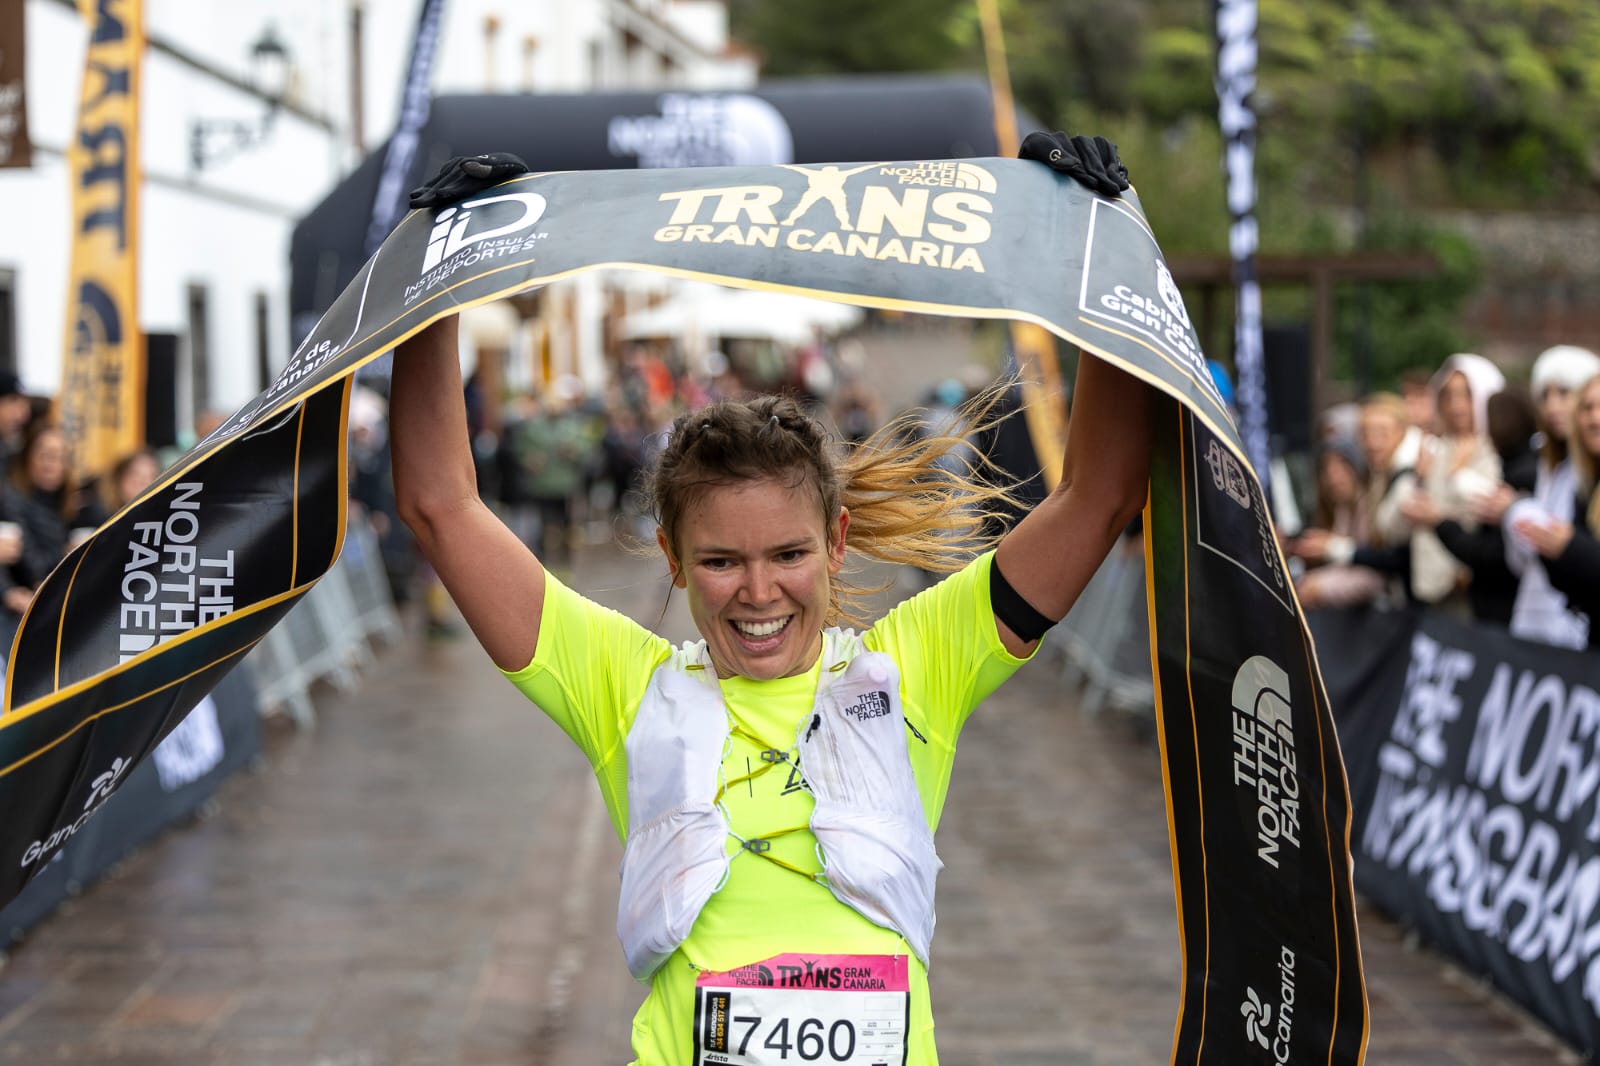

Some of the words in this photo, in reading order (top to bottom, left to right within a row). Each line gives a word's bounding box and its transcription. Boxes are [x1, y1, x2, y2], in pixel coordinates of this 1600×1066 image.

[880, 167, 955, 179] NORTH
[898, 176, 954, 187] FACE
[915, 161, 956, 171] THE
[654, 224, 780, 247] GRAN
[787, 229, 986, 273] CANARIA
[404, 290, 423, 306] DE
[426, 240, 536, 291] DEPORTES
[1100, 294, 1161, 331] Gran
[1114, 285, 1195, 350] Cabildo
[305, 340, 331, 361] de
[160, 482, 204, 630] NORTH
[120, 521, 163, 630] FACE
[199, 549, 235, 628] THE
[845, 700, 880, 716] NORTH
[857, 691, 878, 704] THE
[857, 708, 881, 722] FACE
[1232, 711, 1256, 787] THE
[1258, 723, 1280, 869] NORTH
[1280, 745, 1300, 849] FACE
[736, 978, 757, 986] FACE
[844, 967, 871, 978] GRAN
[844, 979, 886, 990] CANARIA
[733, 1016, 856, 1062] 7460
